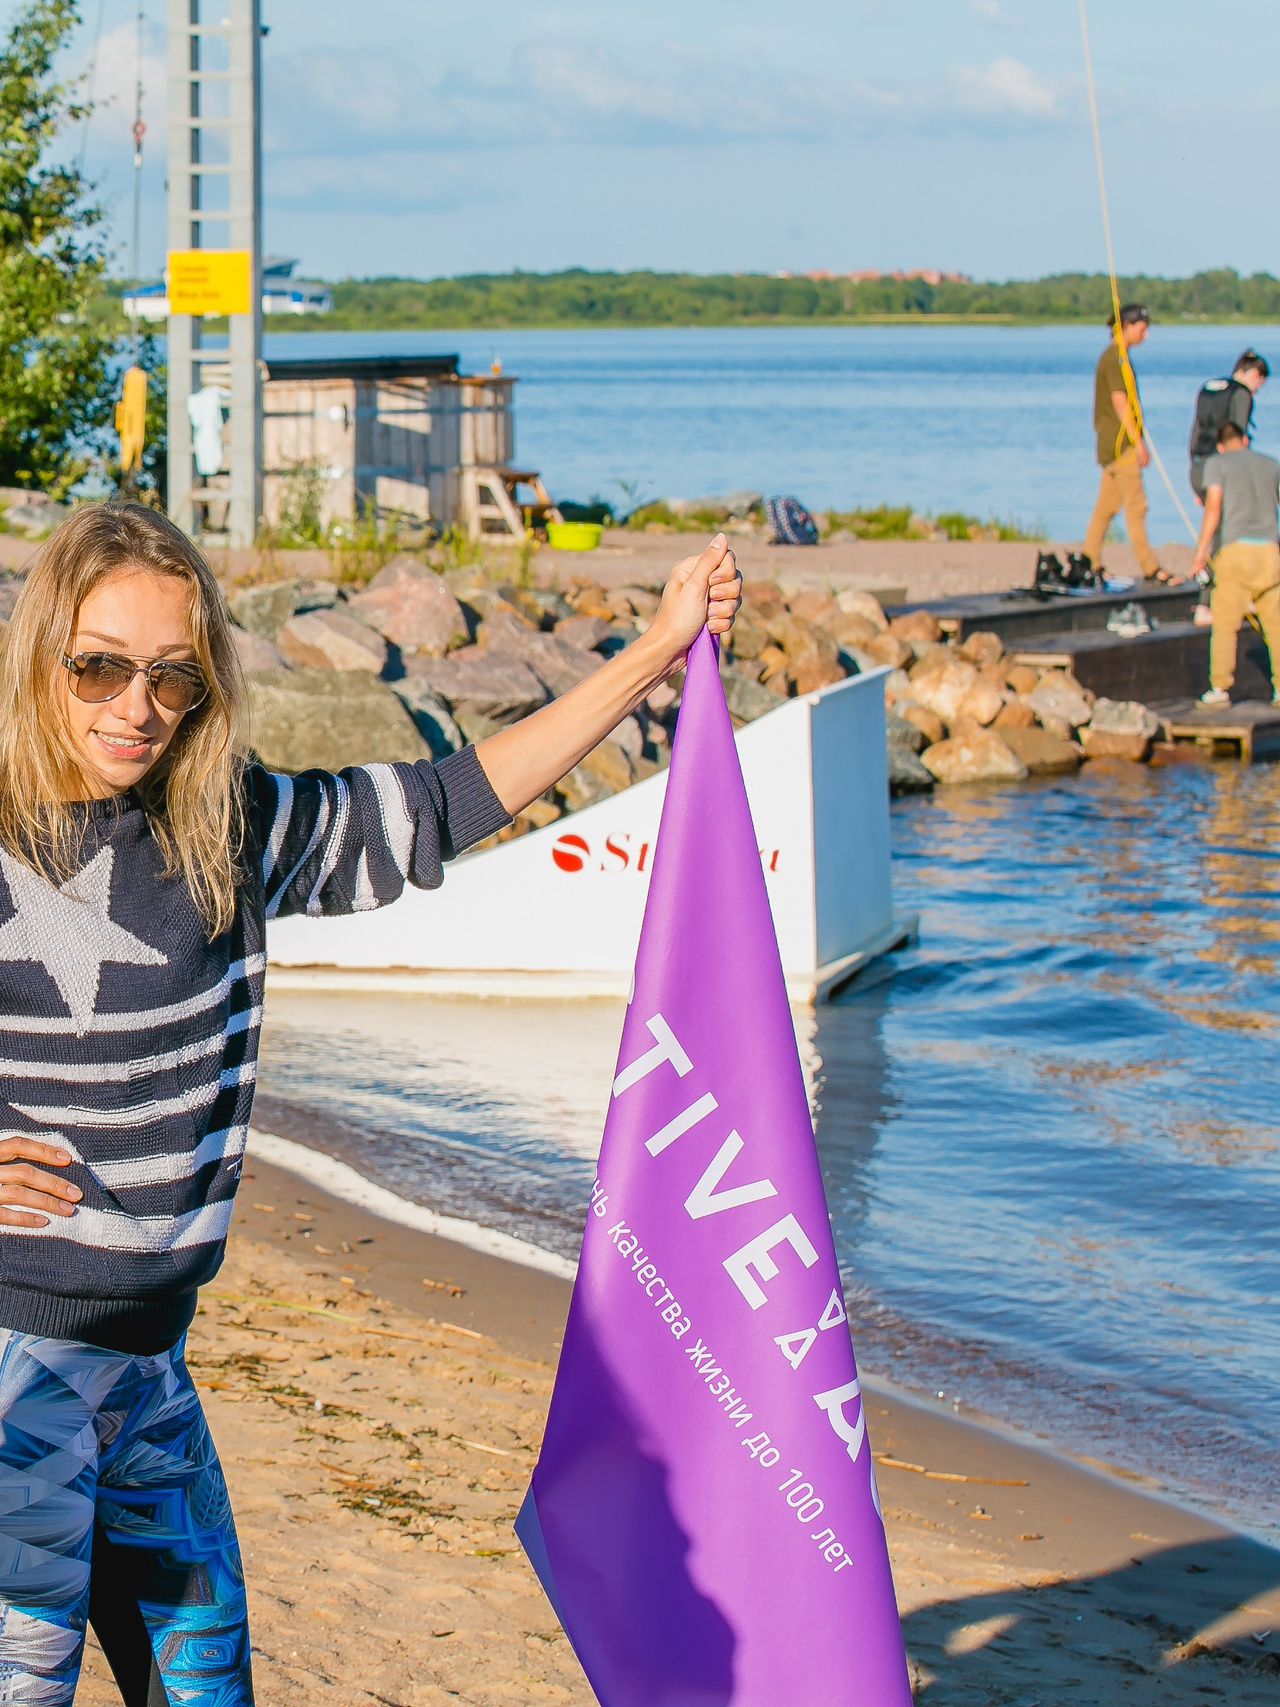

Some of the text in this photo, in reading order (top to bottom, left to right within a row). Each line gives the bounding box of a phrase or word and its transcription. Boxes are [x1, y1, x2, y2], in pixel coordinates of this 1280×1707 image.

[612, 976, 820, 1311] TIVE
[590, 1179, 853, 1572] нь качества жизни до 100 лет
